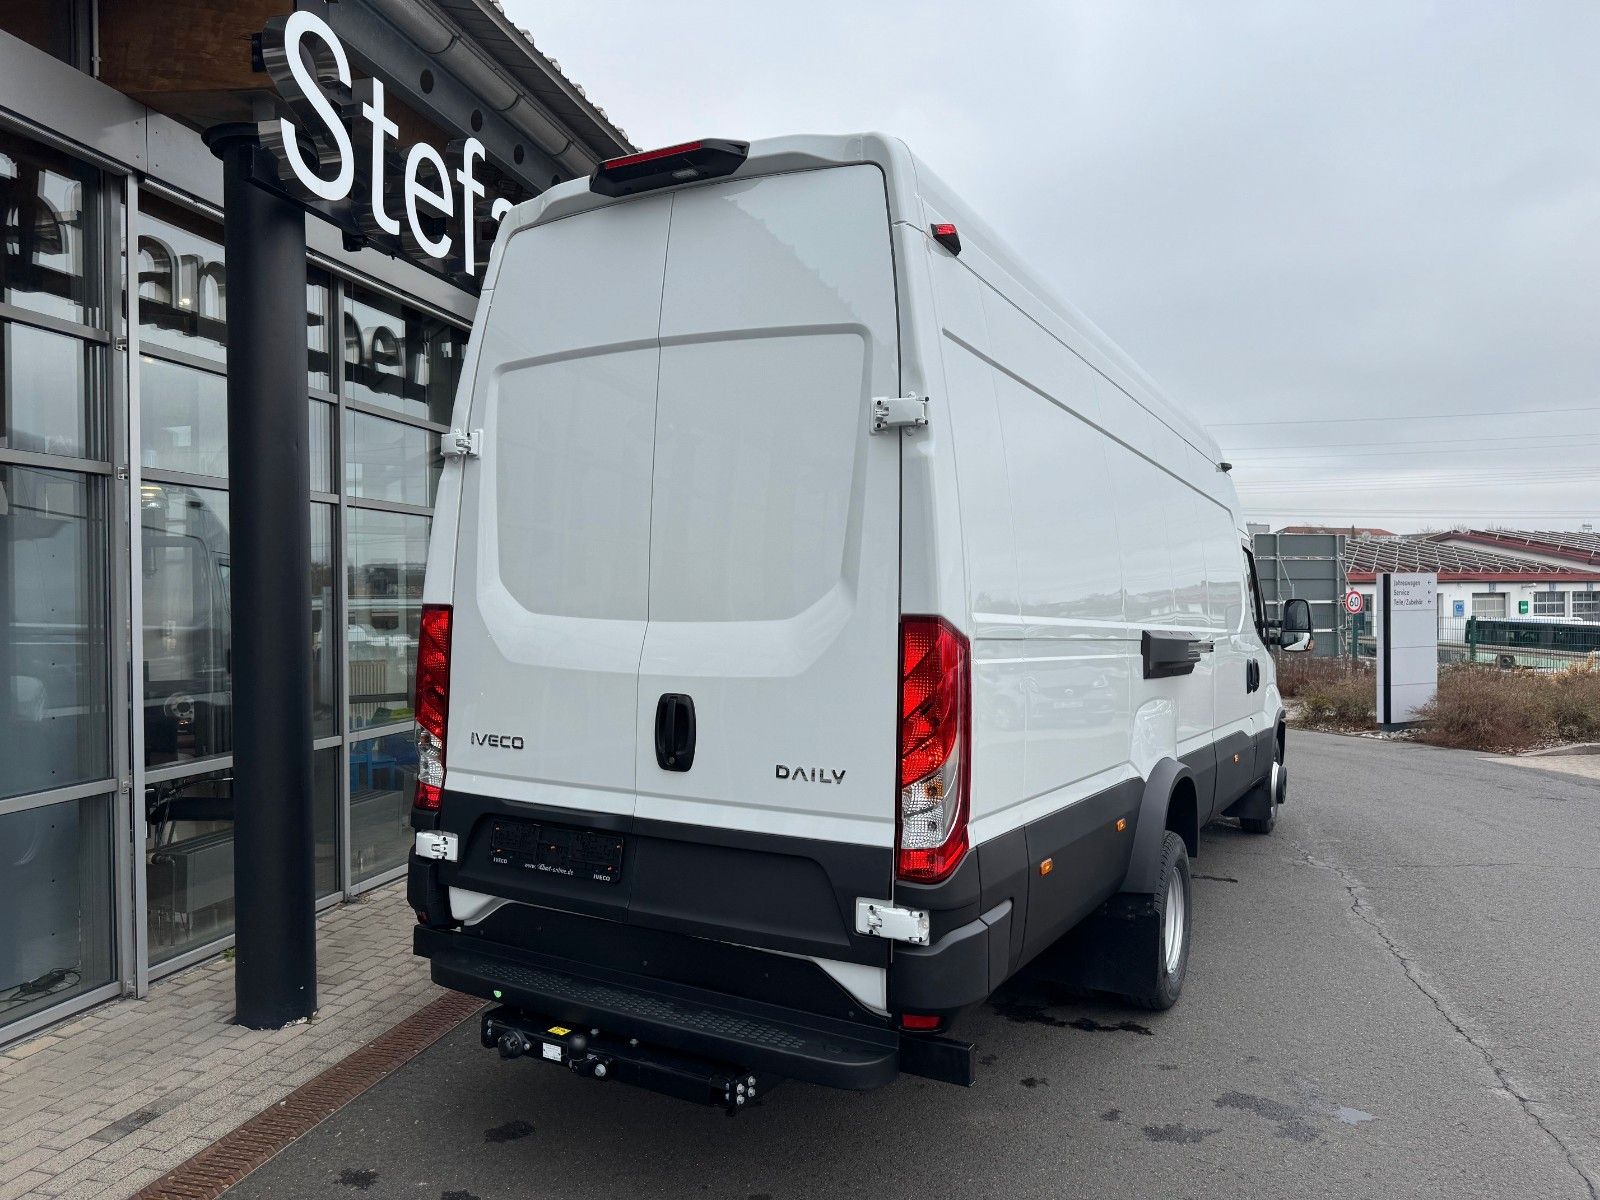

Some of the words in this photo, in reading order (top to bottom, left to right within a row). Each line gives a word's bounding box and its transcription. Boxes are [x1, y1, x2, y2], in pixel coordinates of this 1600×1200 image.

[280, 10, 515, 276] Stef
[1349, 596, 1359, 607] 60
[470, 731, 524, 750] IVECO
[775, 764, 846, 785] DAILY
[493, 856, 508, 864] IVECO
[593, 873, 611, 882] IVECO
